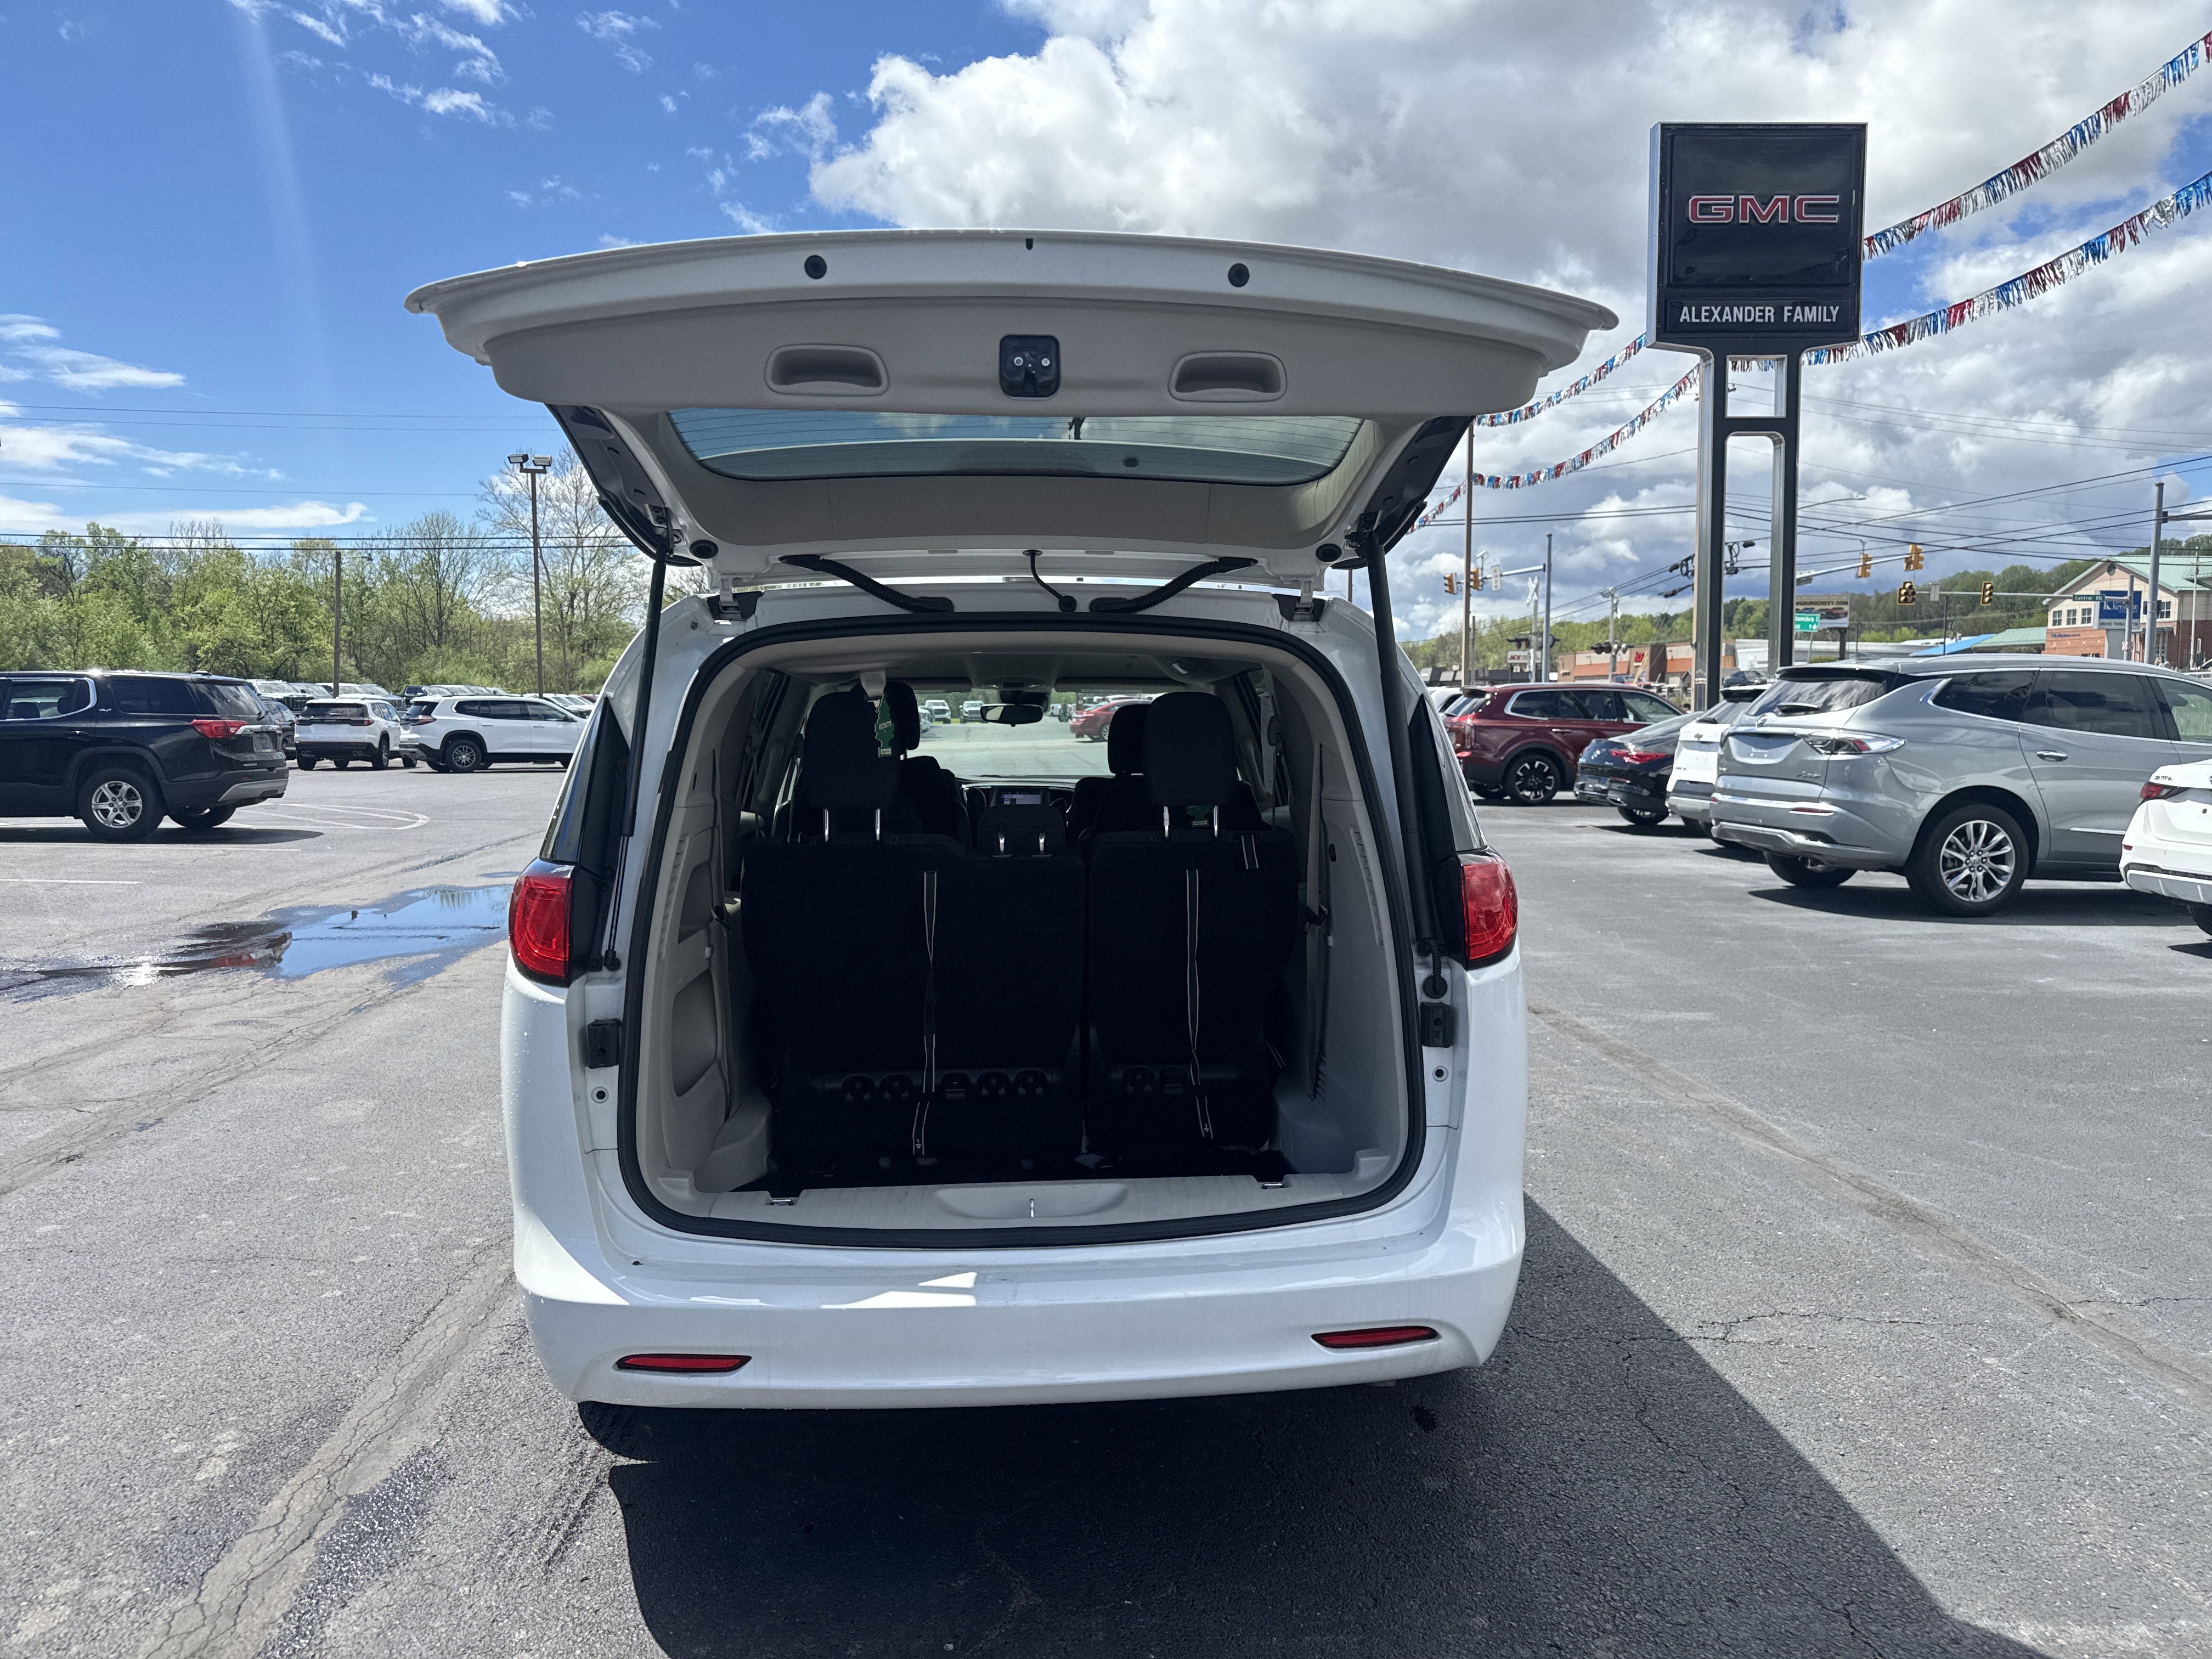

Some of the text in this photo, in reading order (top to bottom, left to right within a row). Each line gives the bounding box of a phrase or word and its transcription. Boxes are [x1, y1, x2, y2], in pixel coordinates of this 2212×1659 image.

[1689, 195, 1839, 223] GMC
[1679, 305, 1839, 323] ALEXANDER FAMILY
